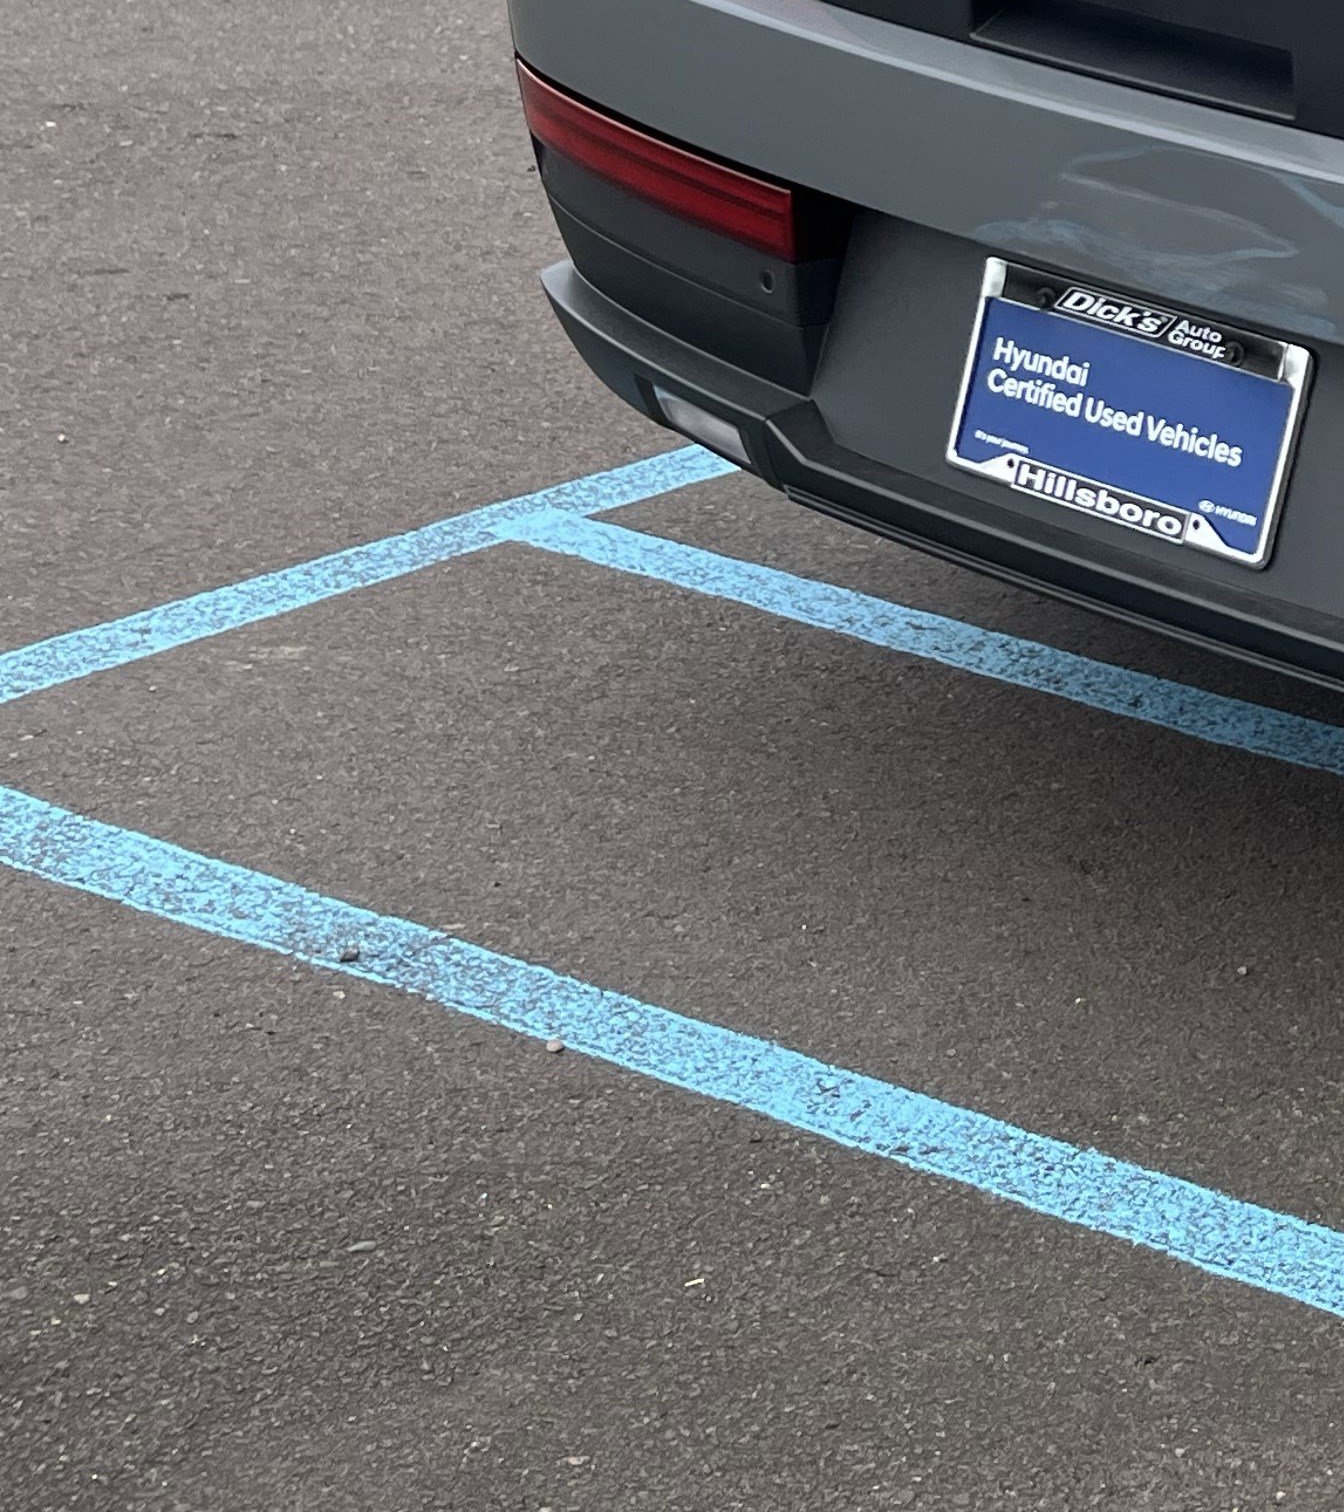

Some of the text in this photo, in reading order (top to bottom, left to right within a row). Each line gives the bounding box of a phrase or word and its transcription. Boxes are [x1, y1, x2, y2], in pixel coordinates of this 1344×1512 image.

[1062, 291, 1163, 333] Dick's
[1174, 319, 1223, 344] Auto
[991, 336, 1091, 387] Hyundai
[986, 368, 1244, 468] Certified Used Vehicles
[1017, 463, 1185, 537] Hillsboro
